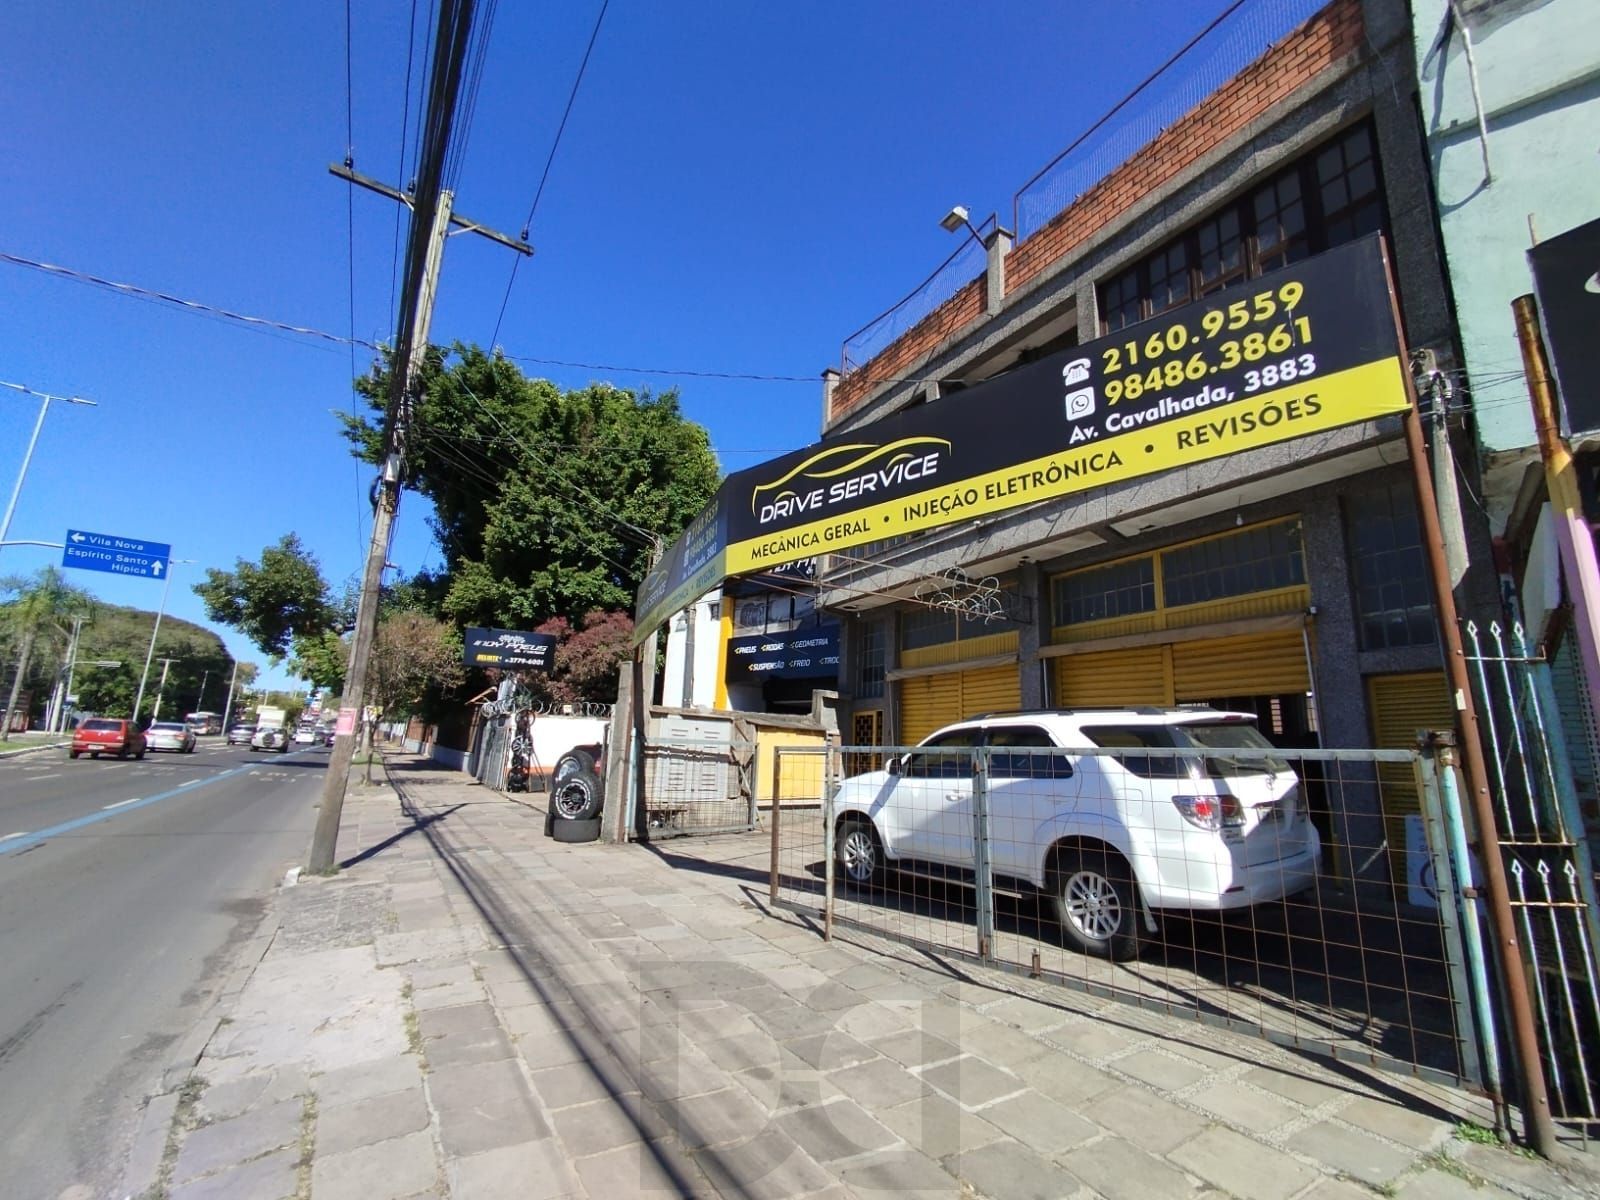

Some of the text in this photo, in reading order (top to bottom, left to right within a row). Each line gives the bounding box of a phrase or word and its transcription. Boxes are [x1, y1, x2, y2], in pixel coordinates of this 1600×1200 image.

[1102, 281, 1305, 375] 2160.9559
[1104, 315, 1313, 406] 98486.3861
[1069, 353, 1317, 444] Av. Cavalhada, 3883
[751, 394, 1323, 560] MECÂNICA GERAL INJEÇÃO ELETRÔNICA REVISÕES
[760, 452, 940, 524] DRIVE SERVICE
[68, 547, 148, 565] Espírito Santo
[89, 536, 144, 551] Vila Nova
[112, 563, 147, 575] Hípica
[739, 646, 757, 654] PNEUS
[794, 638, 829, 649] GEOMETRIA
[753, 656, 840, 672] SUSPENSÃO FREIO TROC
